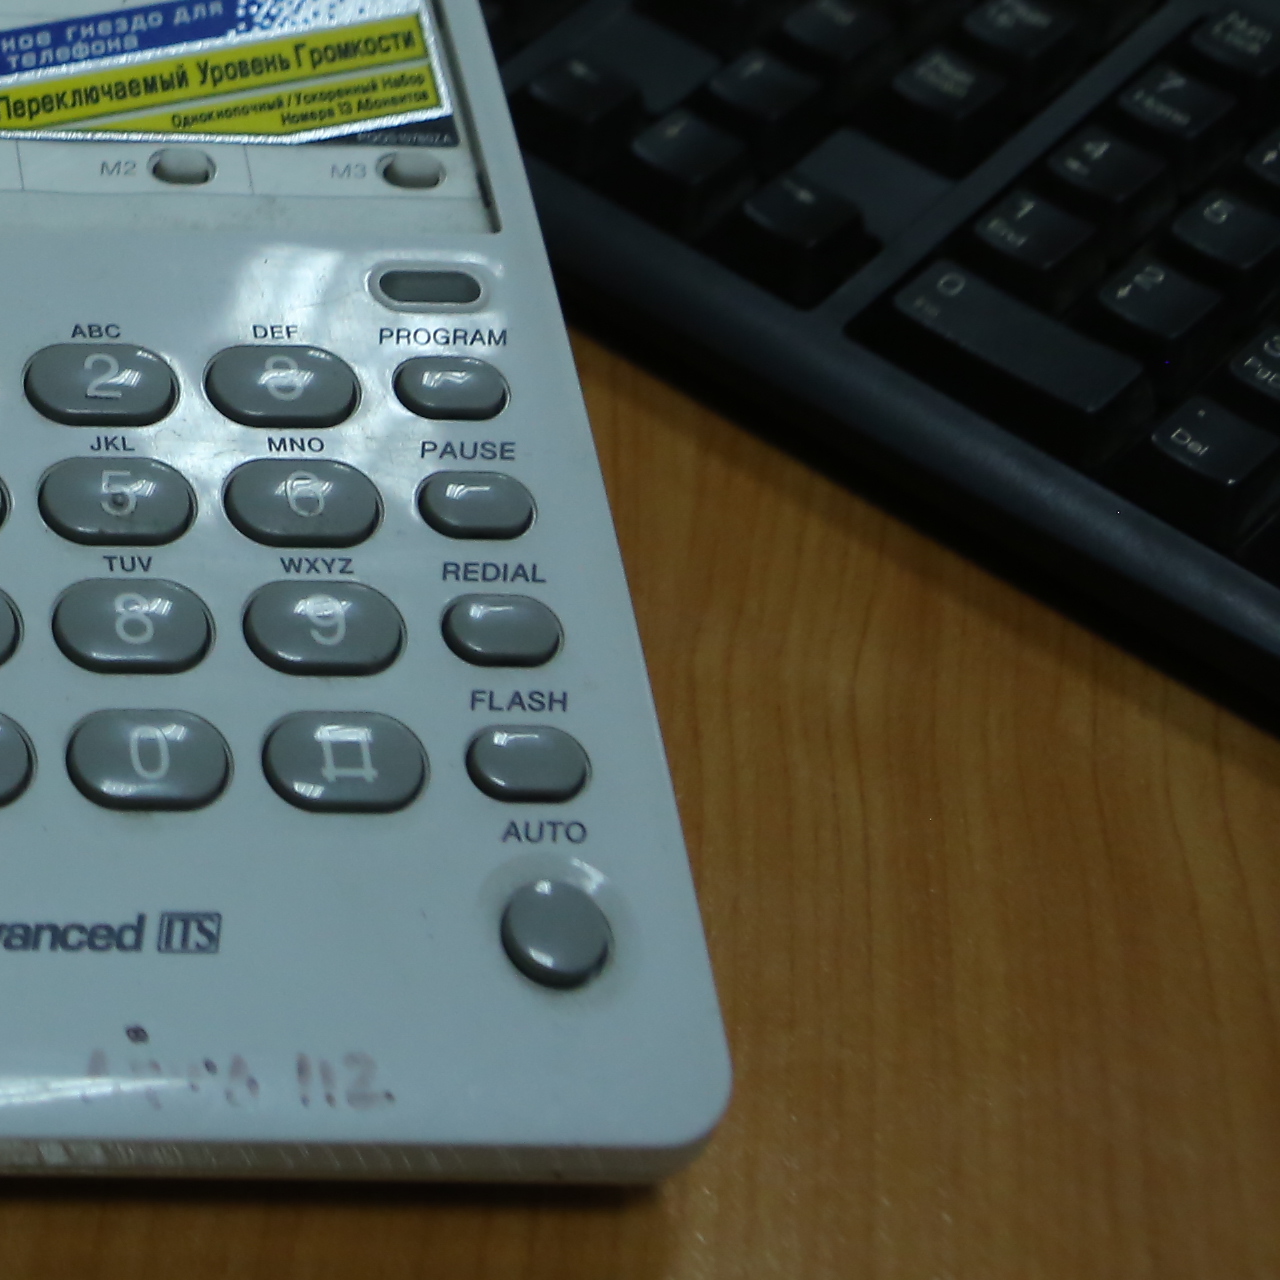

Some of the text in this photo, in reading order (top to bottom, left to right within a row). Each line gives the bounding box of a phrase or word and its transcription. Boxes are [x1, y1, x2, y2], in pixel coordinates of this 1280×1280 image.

[64, 10, 165, 43] гнездо
[171, 0, 225, 28] для
[7, 32, 140, 71] телефона
[195, 53, 291, 89] Уровень
[292, 29, 417, 72] Громкости
[99, 160, 139, 176] M2
[330, 163, 367, 179] M3
[70, 322, 122, 340] ABC
[252, 323, 300, 341] DEF
[377, 326, 510, 349] PROGRAM
[84, 354, 124, 401] 2
[89, 434, 136, 452] JKL
[266, 435, 326, 454] MNO
[418, 440, 517, 462] PAUSE
[1169, 426, 1210, 457] Del
[99, 469, 139, 518] 5
[284, 469, 326, 518] 6
[102, 555, 154, 573] TUV
[279, 556, 355, 576] WXYZ
[440, 562, 547, 584] REDIAL
[113, 592, 156, 646] 8
[302, 593, 347, 647] 9
[469, 690, 568, 714] FLASH
[128, 726, 171, 780] 0
[500, 820, 588, 845] AUTO
[157, 912, 223, 954] ITS
